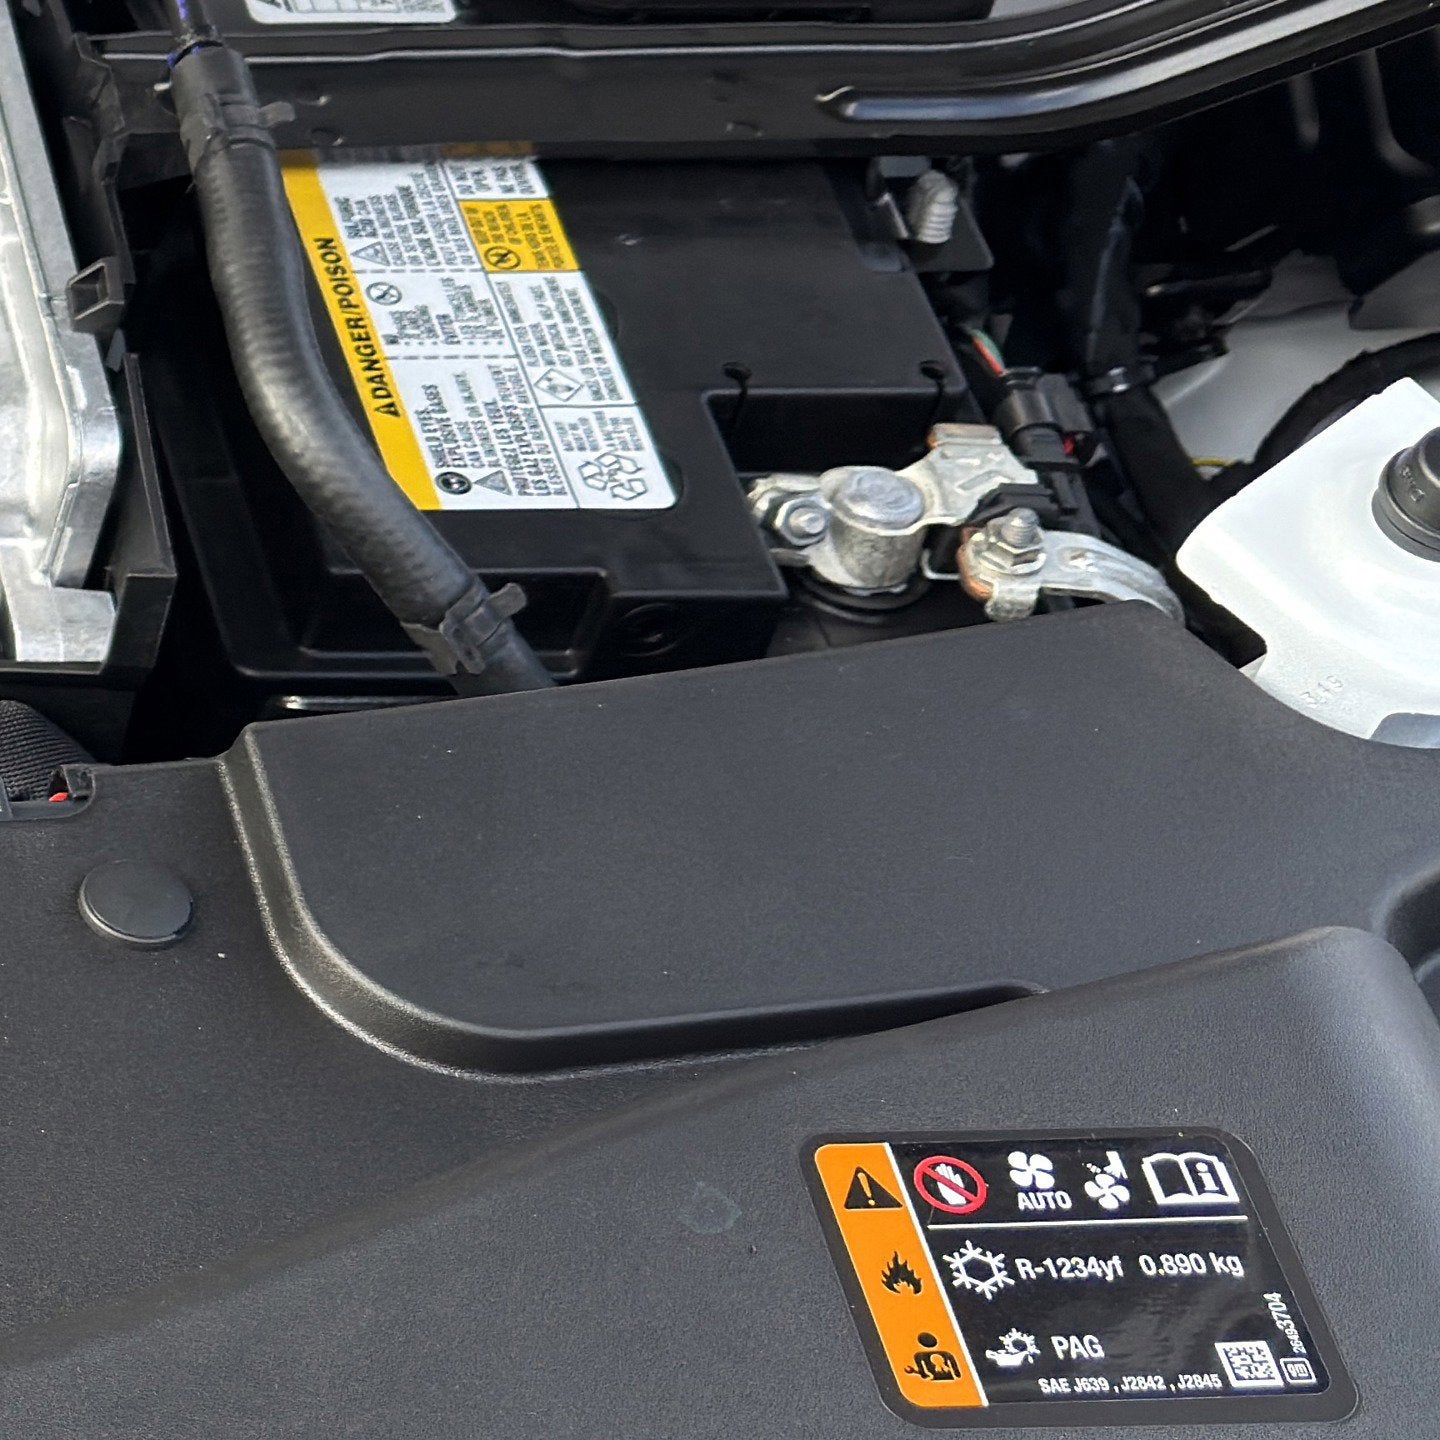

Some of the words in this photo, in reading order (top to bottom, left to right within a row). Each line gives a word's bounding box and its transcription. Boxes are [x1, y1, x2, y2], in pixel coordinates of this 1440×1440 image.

[316, 238, 390, 398] DANGER/POISON
[1018, 1190, 1072, 1210] AUTO
[1015, 1255, 1124, 1281] R-1234yf
[1138, 1252, 1206, 1277] 0.890
[1209, 1252, 1245, 1277] kg
[1051, 1334, 1105, 1360] PAG
[1038, 1377, 1071, 1394] SAE
[1074, 1377, 1110, 1393] J639
